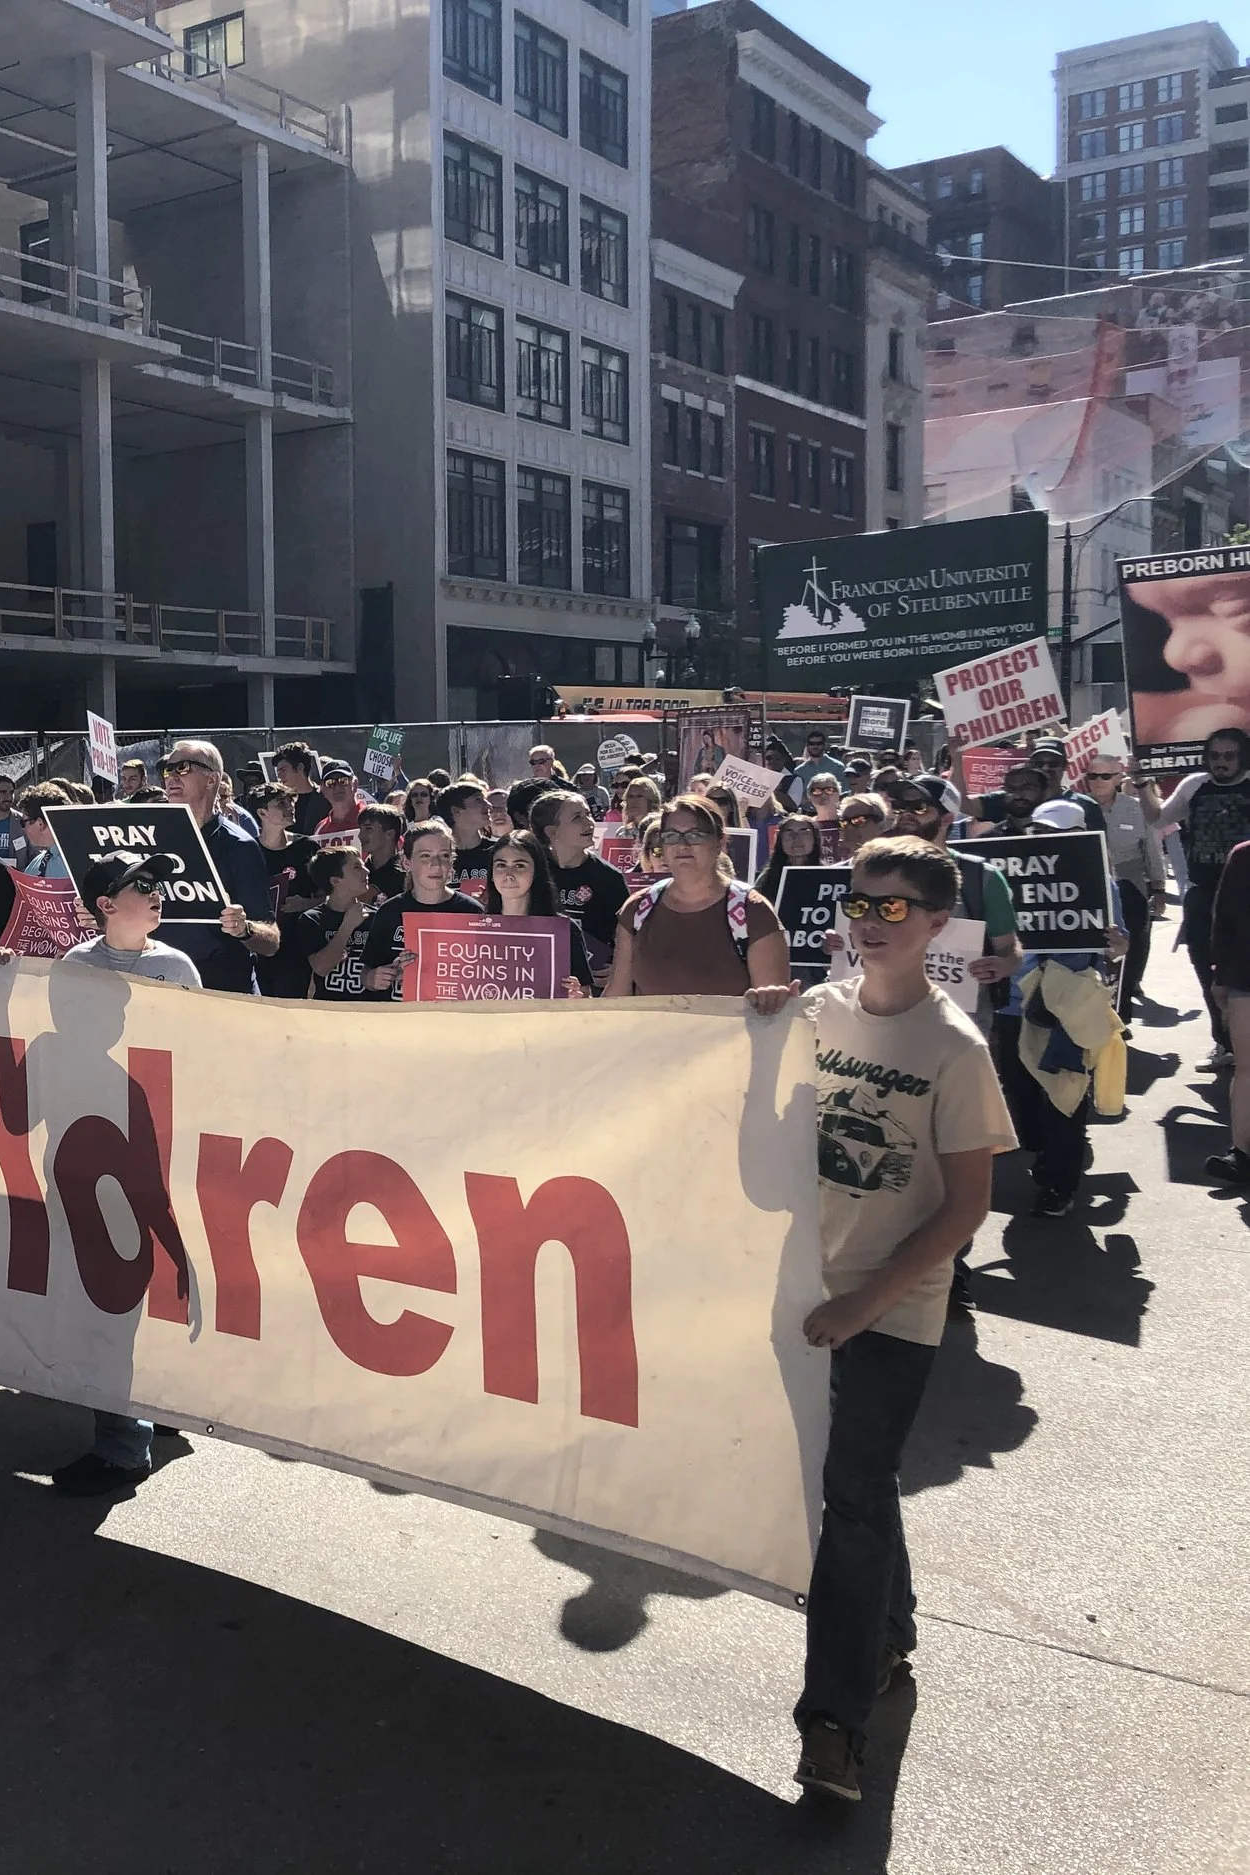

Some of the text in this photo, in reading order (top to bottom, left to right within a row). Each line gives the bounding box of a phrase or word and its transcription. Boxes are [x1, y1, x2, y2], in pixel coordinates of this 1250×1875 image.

[1121, 553, 1225, 579] PREBORN
[867, 602, 892, 618] OF
[824, 640, 868, 652] FORMED
[870, 638, 894, 649] YOU
[894, 636, 906, 646] IN
[908, 633, 930, 644] THE
[931, 630, 967, 641] WOMB
[974, 625, 1007, 637] KNEW
[786, 655, 826, 667] BEFORE
[828, 653, 851, 663] YOU
[851, 650, 881, 661] WERE
[883, 647, 913, 658] BORN
[920, 640, 983, 655] DEDICATED
[944, 644, 1040, 696] PROTECT
[979, 678, 1026, 711] OUR
[954, 693, 1061, 747] CHILDREN
[92, 719, 112, 750] VOTE
[372, 726, 403, 746] LOVE LIFE
[1064, 717, 1111, 759] OTECT
[92, 746, 117, 777] PRO-LIFE
[372, 763, 385, 777] LIFE
[721, 775, 767, 798] VOICELESS
[725, 767, 754, 785] VOICE
[969, 774, 1006, 784] BEGIN
[92, 825, 157, 847] PRAY
[450, 868, 488, 884] LASS
[1022, 882, 1080, 904] END
[26, 894, 73, 915] EQUALIT
[801, 907, 831, 925] TO
[1016, 909, 1104, 931] RTION
[30, 940, 59, 955] WOM
[438, 942, 535, 964] EQUALITY
[939, 952, 964, 965] the
[325, 957, 367, 994] 25
[436, 962, 535, 982] BEGINS IN
[436, 983, 535, 1000] THE WOMB
